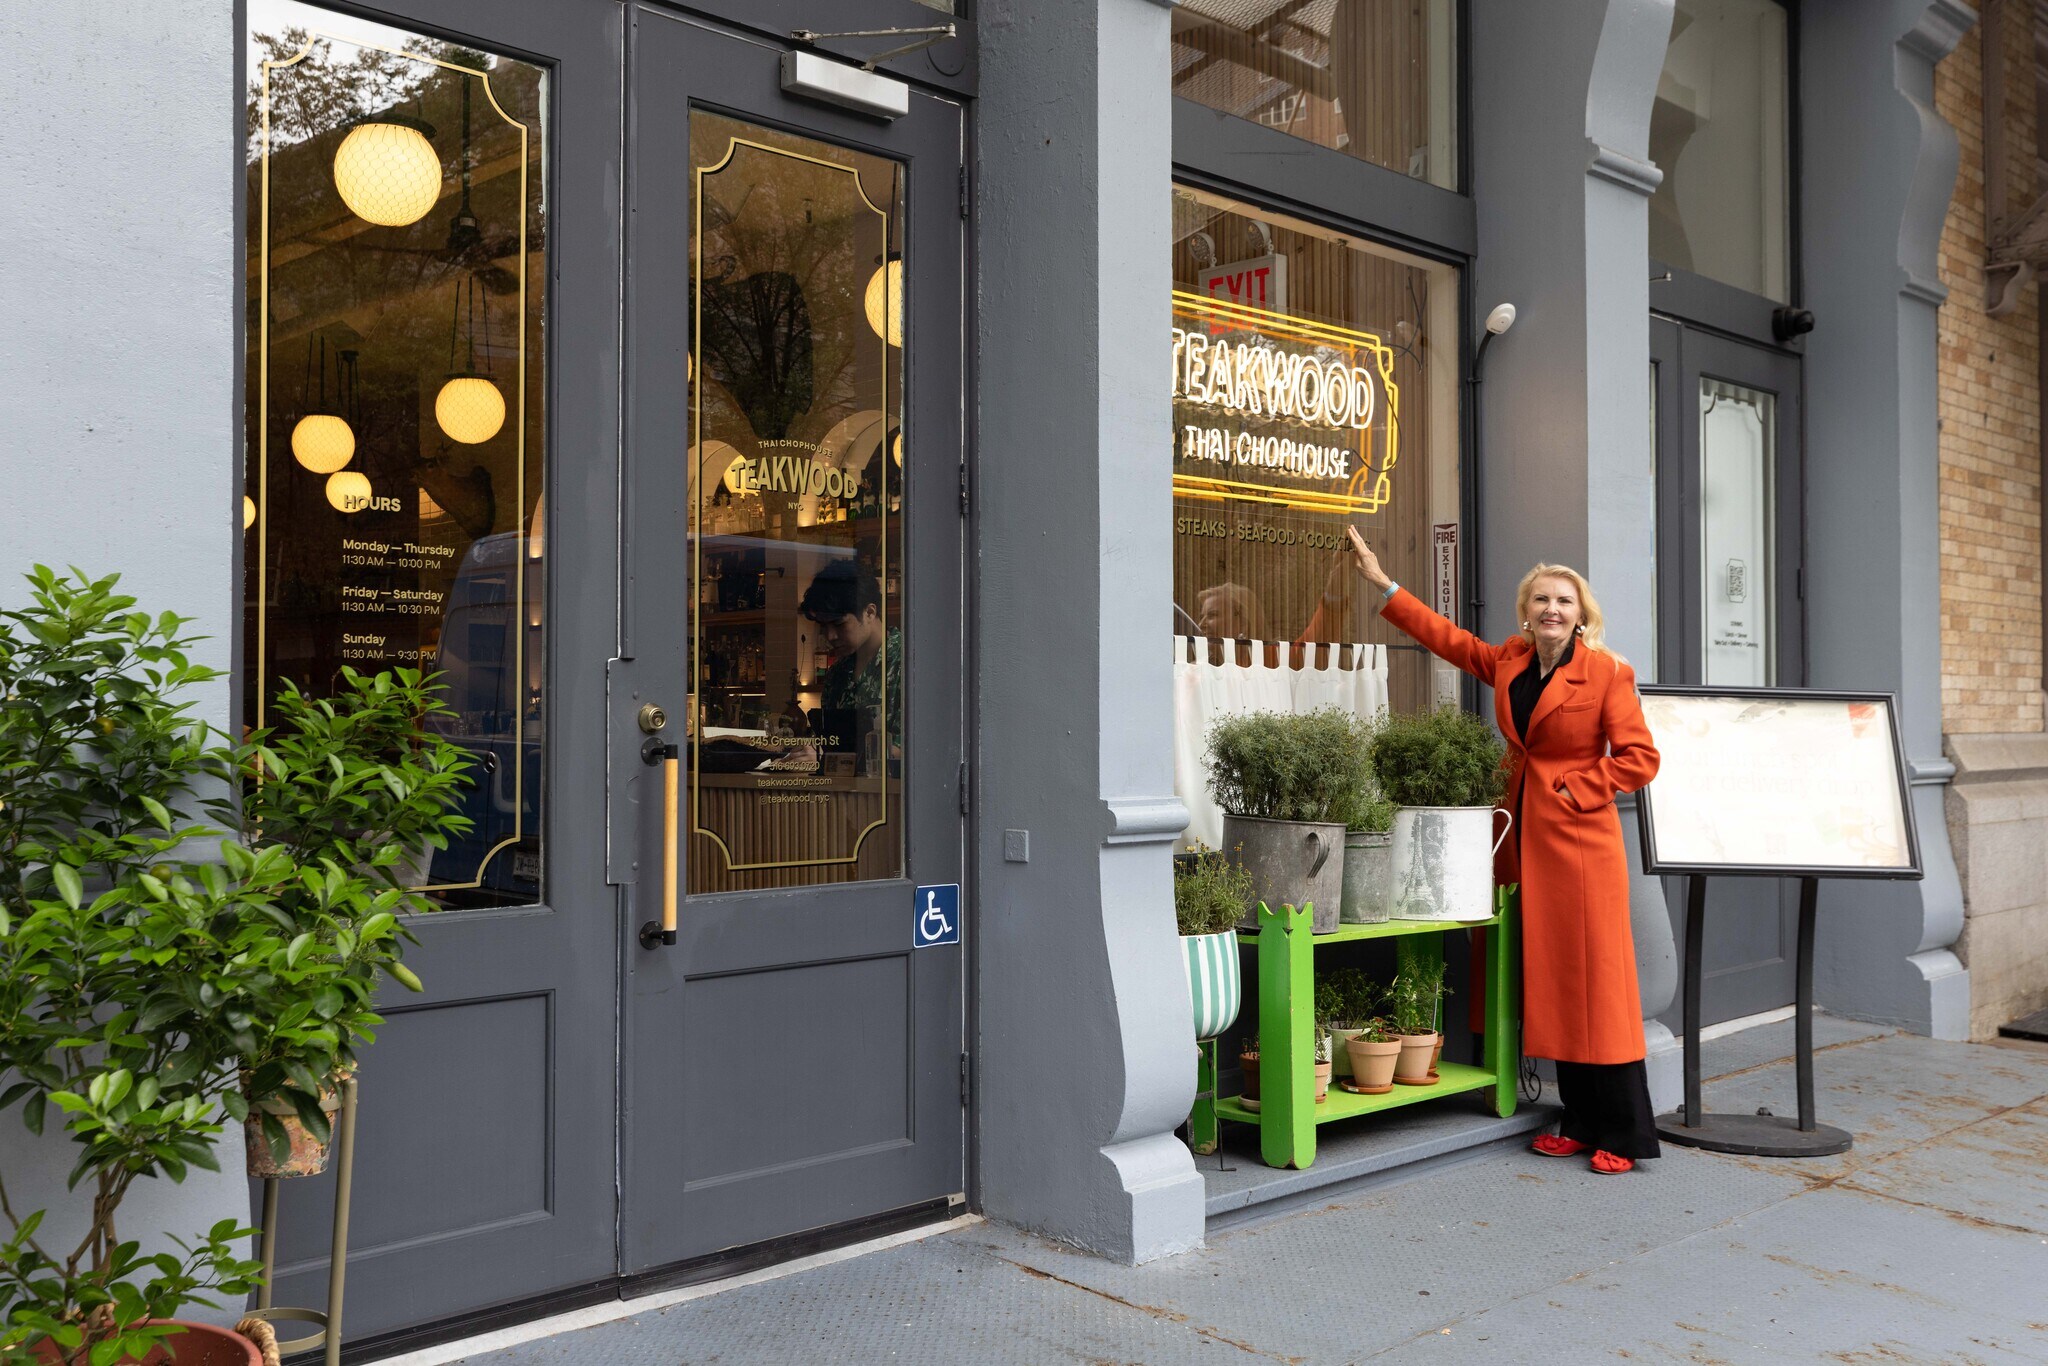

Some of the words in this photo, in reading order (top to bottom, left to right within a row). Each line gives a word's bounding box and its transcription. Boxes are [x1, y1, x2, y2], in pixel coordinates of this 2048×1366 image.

[1209, 267, 1270, 335] EXIT
[758, 440, 778, 449] THAI
[780, 439, 833, 458] CHOPHOUSE
[1185, 425, 1230, 461] THAI
[1237, 432, 1350, 479] CHOPHOUSE
[732, 456, 858, 499] TEAKWOOD
[343, 495, 401, 512] HOURS
[788, 502, 804, 511] NYC
[1177, 517, 1226, 538] STEAKS
[1238, 524, 1295, 545] SEAFOOD
[1436, 531, 1455, 544] FIRE
[343, 539, 390, 554] Monday
[404, 543, 455, 558] Thursday
[343, 555, 365, 565] 11:30
[367, 556, 384, 566] AM
[399, 559, 423, 568] 10:00
[425, 559, 441, 569] PM
[343, 586, 378, 600] Friday
[393, 589, 444, 602] Saturday
[342, 602, 365, 612] 11:30
[367, 603, 384, 612] AM
[398, 604, 422, 614] 10:30
[424, 605, 440, 615] PM
[343, 633, 386, 646] Sunday
[343, 649, 365, 659] 11:30
[366, 649, 383, 659] AM
[398, 650, 418, 660] 9:30
[421, 650, 436, 660] PM
[750, 736, 768, 746] 345
[771, 735, 827, 746] Greenwich
[829, 735, 840, 746] St
[757, 777, 832, 787] teakwoodnyc.com
